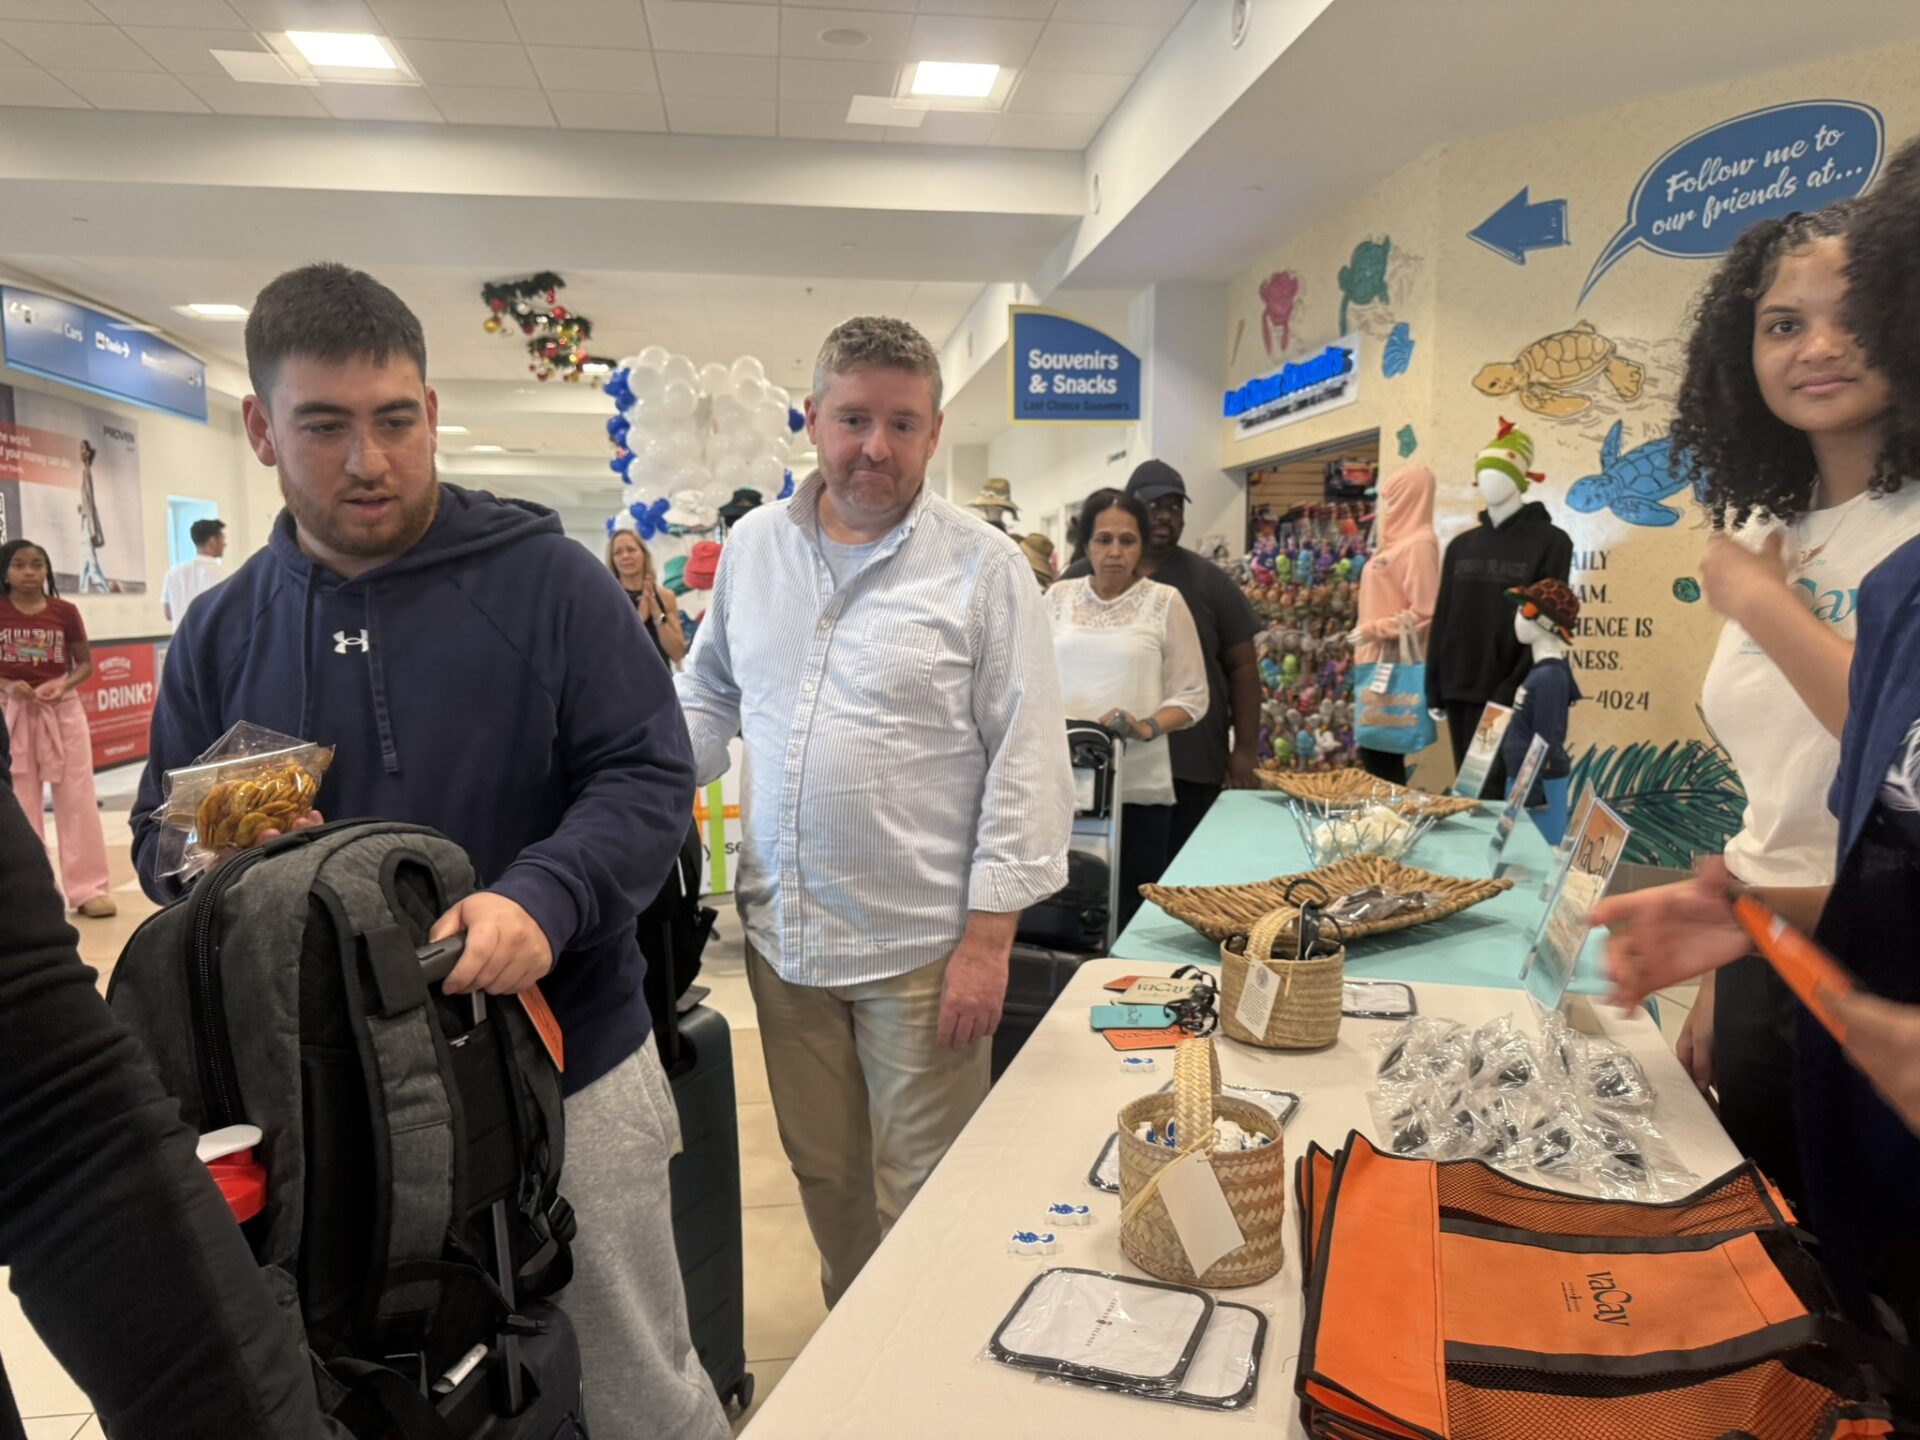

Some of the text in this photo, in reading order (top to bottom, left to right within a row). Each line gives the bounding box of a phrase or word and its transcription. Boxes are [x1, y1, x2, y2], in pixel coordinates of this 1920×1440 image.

[1666, 124, 1846, 202] Follow me to
[1652, 208, 1696, 235] our
[1702, 165, 1800, 229] friends
[1028, 349, 1119, 370] Souvenirs
[1028, 374, 1118, 395] & Snacks
[1570, 550, 1611, 571] AILY
[1574, 584, 1612, 604] AM.
[1573, 617, 1654, 638] IENCE IS
[1569, 650, 1624, 671] NESS.
[97, 681, 153, 712] DRINK?
[1586, 1271, 1632, 1327] vaCay
